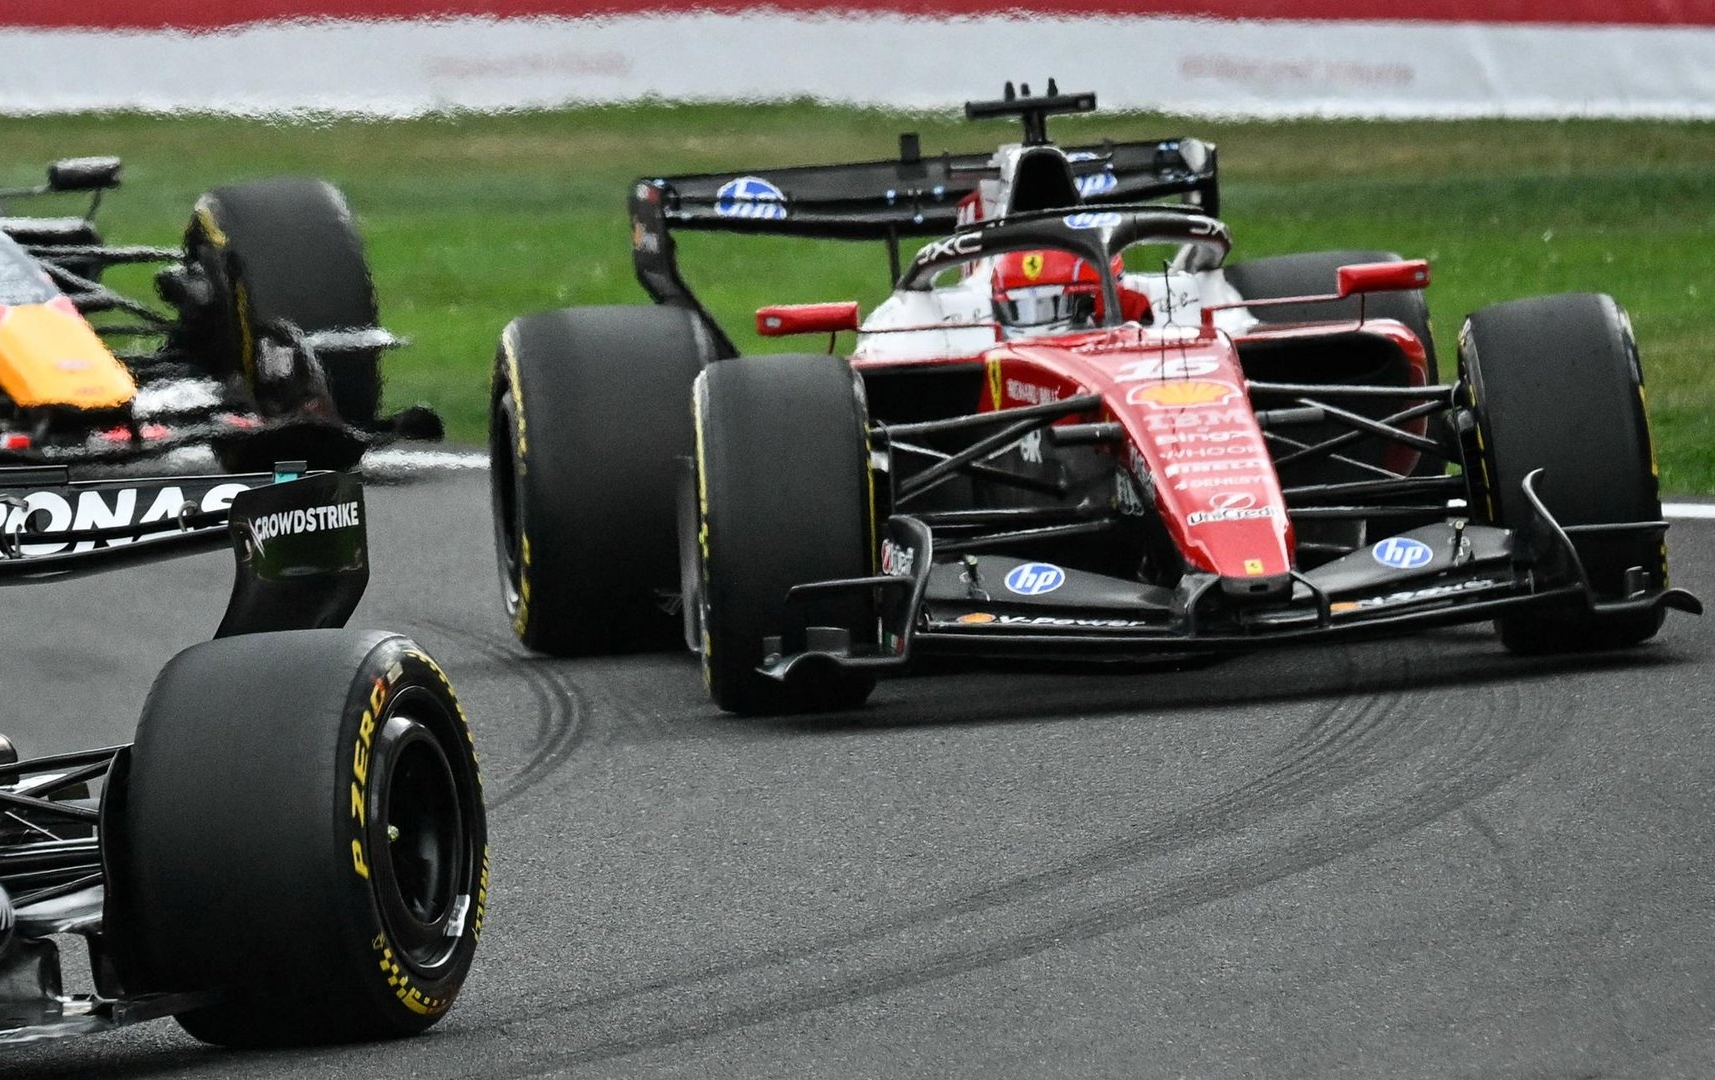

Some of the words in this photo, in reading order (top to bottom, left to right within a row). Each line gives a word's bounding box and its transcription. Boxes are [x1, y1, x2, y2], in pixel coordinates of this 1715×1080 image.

[1114, 356, 1221, 384] 16
[1144, 406, 1249, 432] IBM
[254, 500, 359, 543] CROWDSTRIKE
[1379, 537, 1430, 568] hp
[1010, 562, 1061, 595] hp
